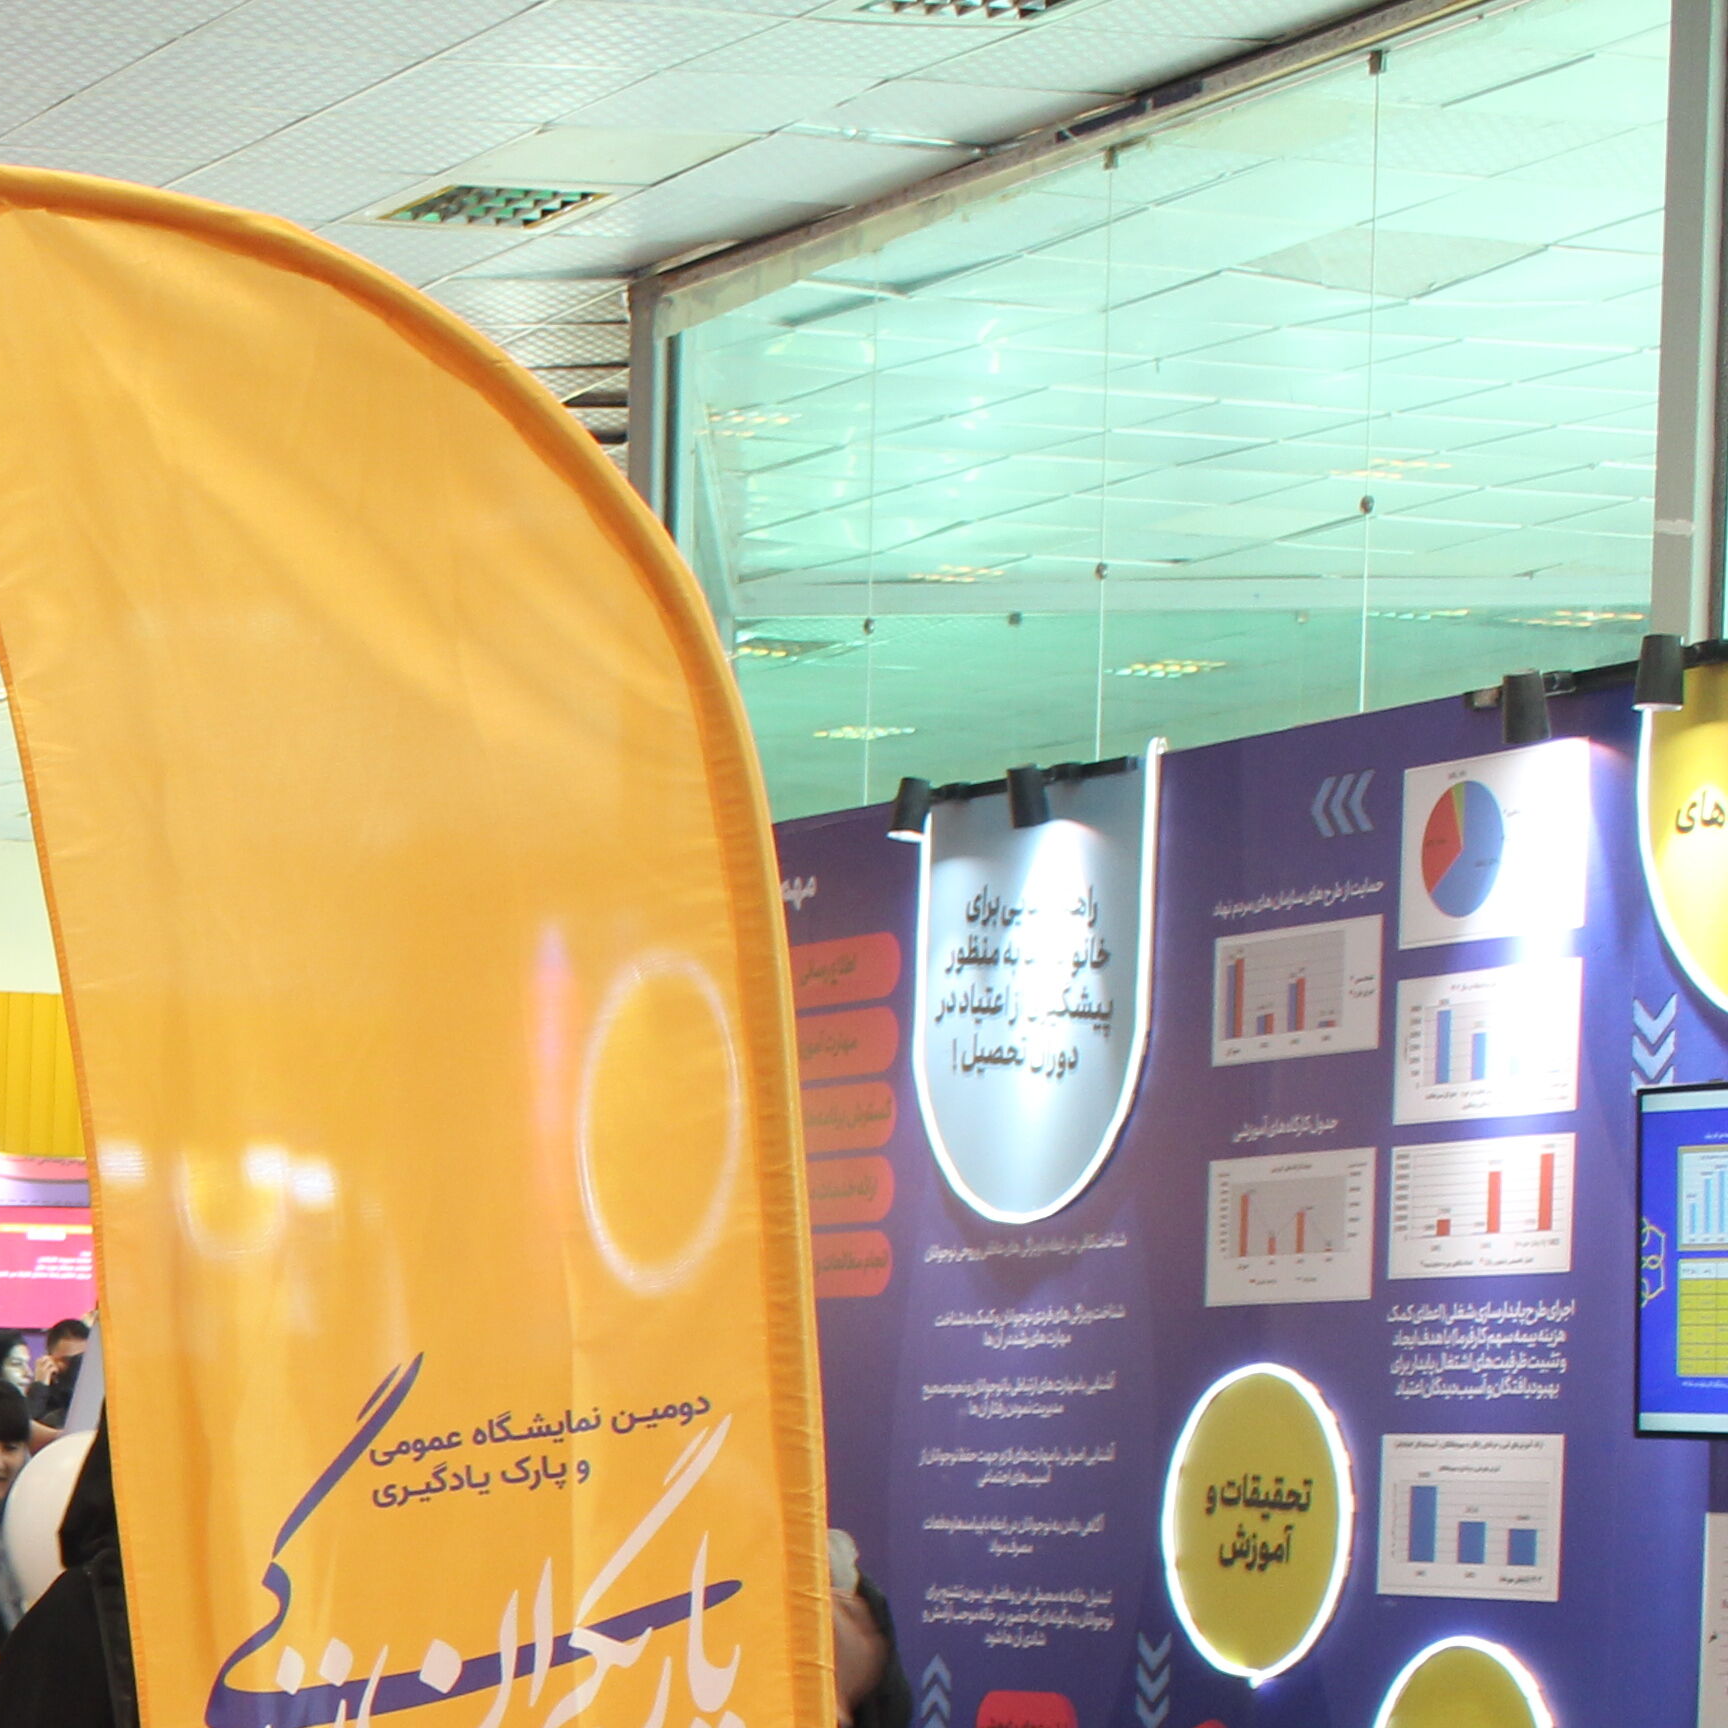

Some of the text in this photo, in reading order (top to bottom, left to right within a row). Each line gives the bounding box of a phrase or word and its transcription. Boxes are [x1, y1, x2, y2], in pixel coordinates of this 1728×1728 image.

[965, 884, 1000, 926] برای
[945, 934, 1000, 974] منظور
[935, 983, 1009, 1024] اعتیاد در
[1387, 1304, 1414, 1323] کمک
[1445, 1302, 1476, 1325] شغلی
[1524, 1300, 1547, 1325] طرح
[1546, 1298, 1576, 1322] اجرای
[1392, 1329, 1419, 1349] ایجاد
[1487, 1330, 1515, 1350] سهم
[1539, 1328, 1568, 1348] هزینه
[1390, 1353, 1412, 1376] برای
[1436, 1352, 1474, 1374] اشتغال
[1396, 1379, 1425, 1400] اعتیاد
[369, 1394, 712, 1469] دومین نمایشگاه عمومی
[371, 1452, 591, 1510] و پارک یادگیری
[1205, 1472, 1313, 1520] تحقیقات و
[1219, 1523, 1295, 1571] آموزش
